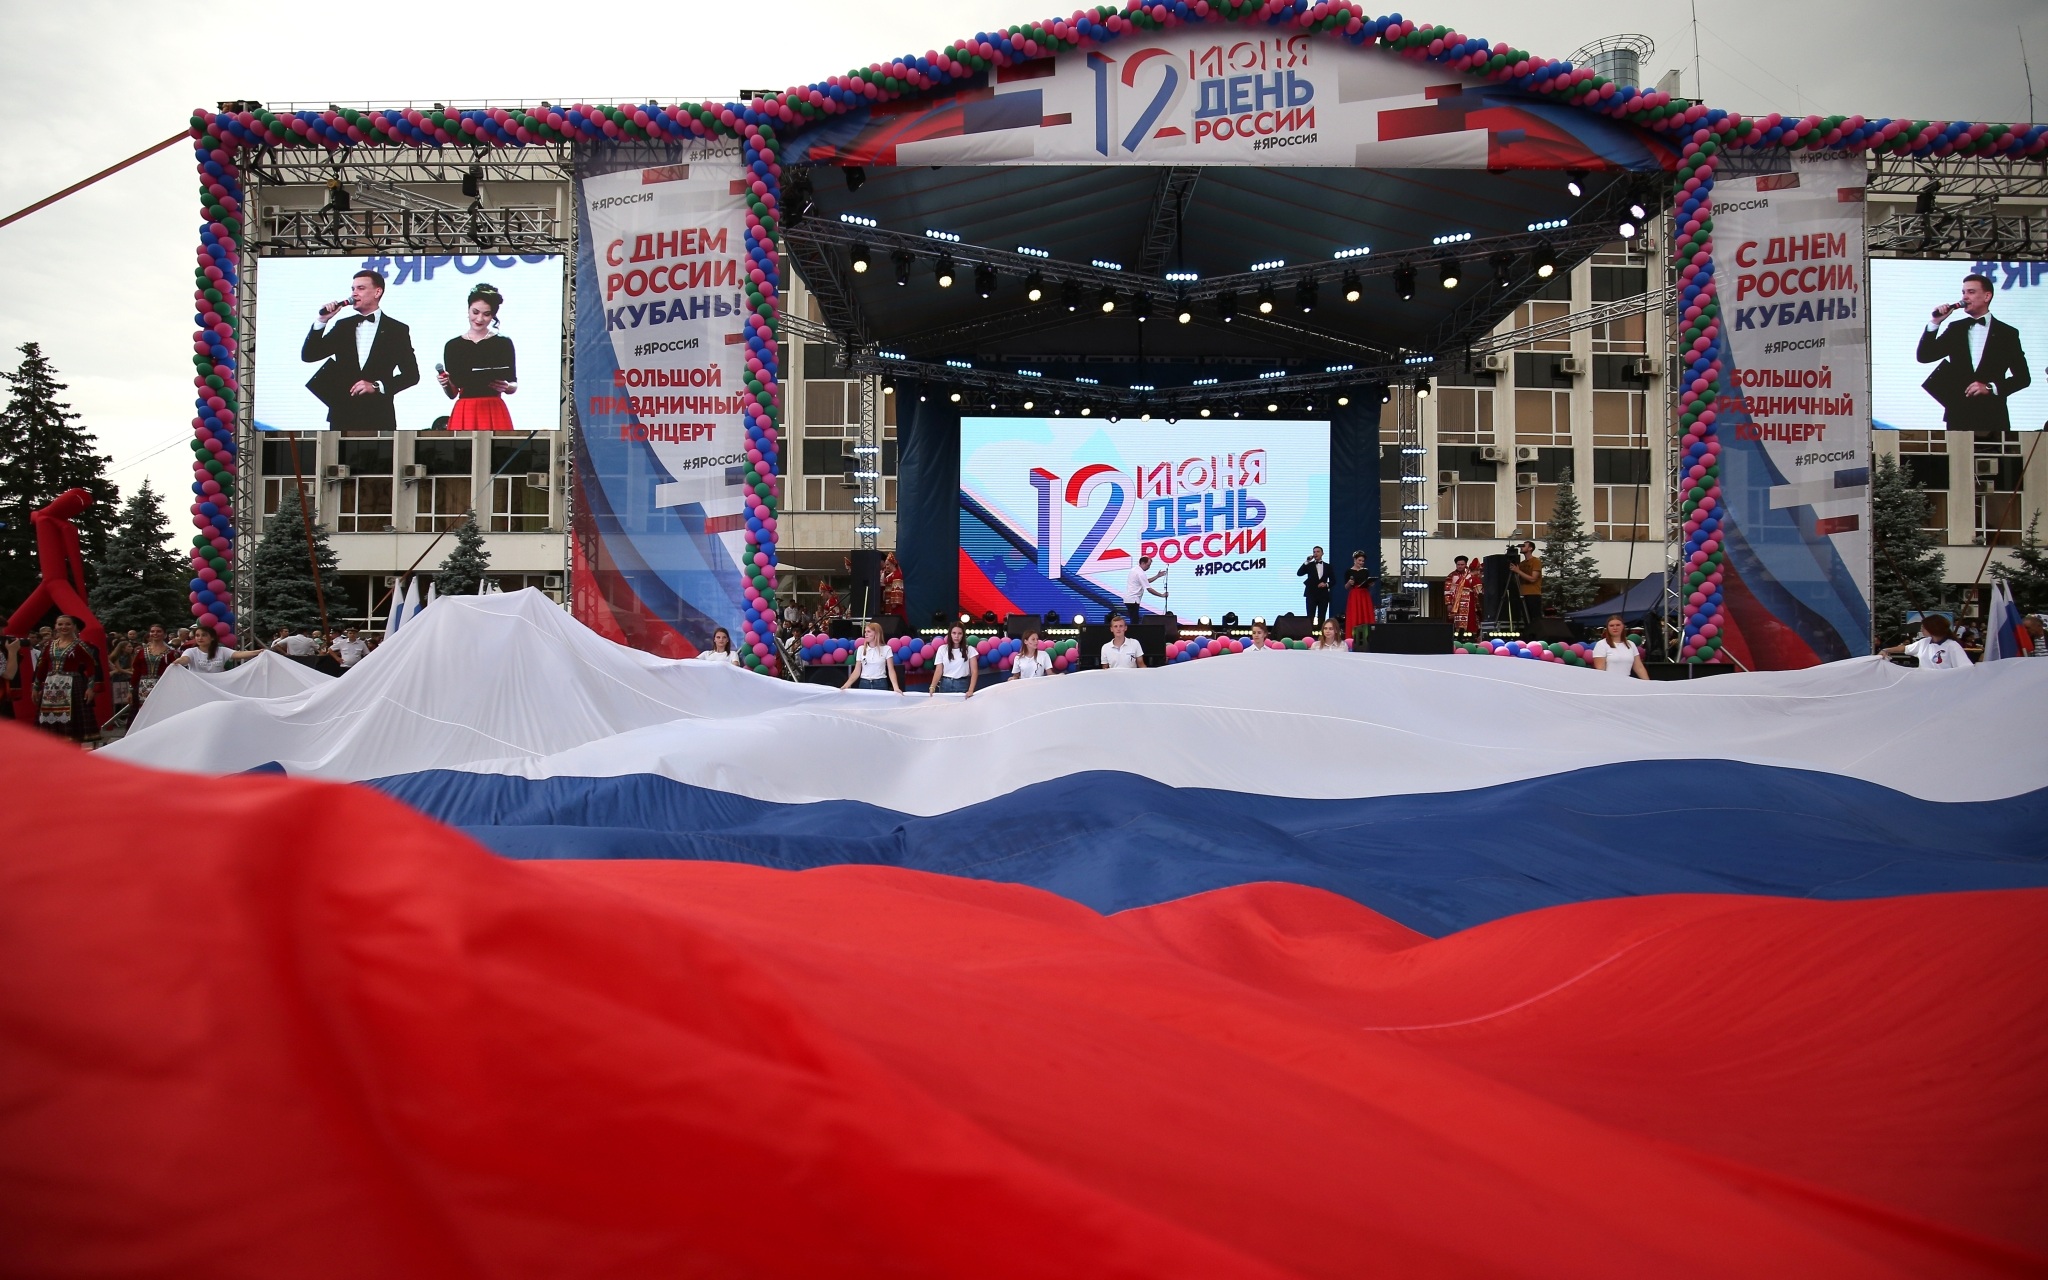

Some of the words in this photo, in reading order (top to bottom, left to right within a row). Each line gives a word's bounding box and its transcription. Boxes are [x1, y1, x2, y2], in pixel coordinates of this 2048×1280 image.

[1087, 48, 1186, 157] 12
[1190, 34, 1313, 80] ИЮНЯ
[1195, 70, 1315, 119] ДЕНЬ
[1195, 106, 1315, 144] РОССИИ
[606, 239, 624, 267] С
[630, 228, 728, 264] ДНЕМ
[1735, 241, 1758, 268] С
[1763, 232, 1847, 265] ДНЕМ
[607, 259, 744, 301] РОССИИ,
[1736, 264, 1859, 302] РОССИИ,
[606, 293, 742, 332] КУБАНЬ!
[1735, 297, 1857, 332] КУБАНЬ!
[613, 363, 722, 388] БОЛЬШОЙ
[1730, 365, 1832, 388] БОЛЬШОЙ
[589, 391, 746, 417] ПРАЗДНИЧНЫЙ
[619, 423, 717, 444] КОНЦЕРТ
[1735, 422, 1827, 444] КОНЦЕРТ
[1030, 464, 1136, 579] 12
[1137, 449, 1267, 499] ИЮНЯ
[1141, 488, 1267, 540] ДЕНЬ
[1141, 527, 1267, 564] РОССИИ
